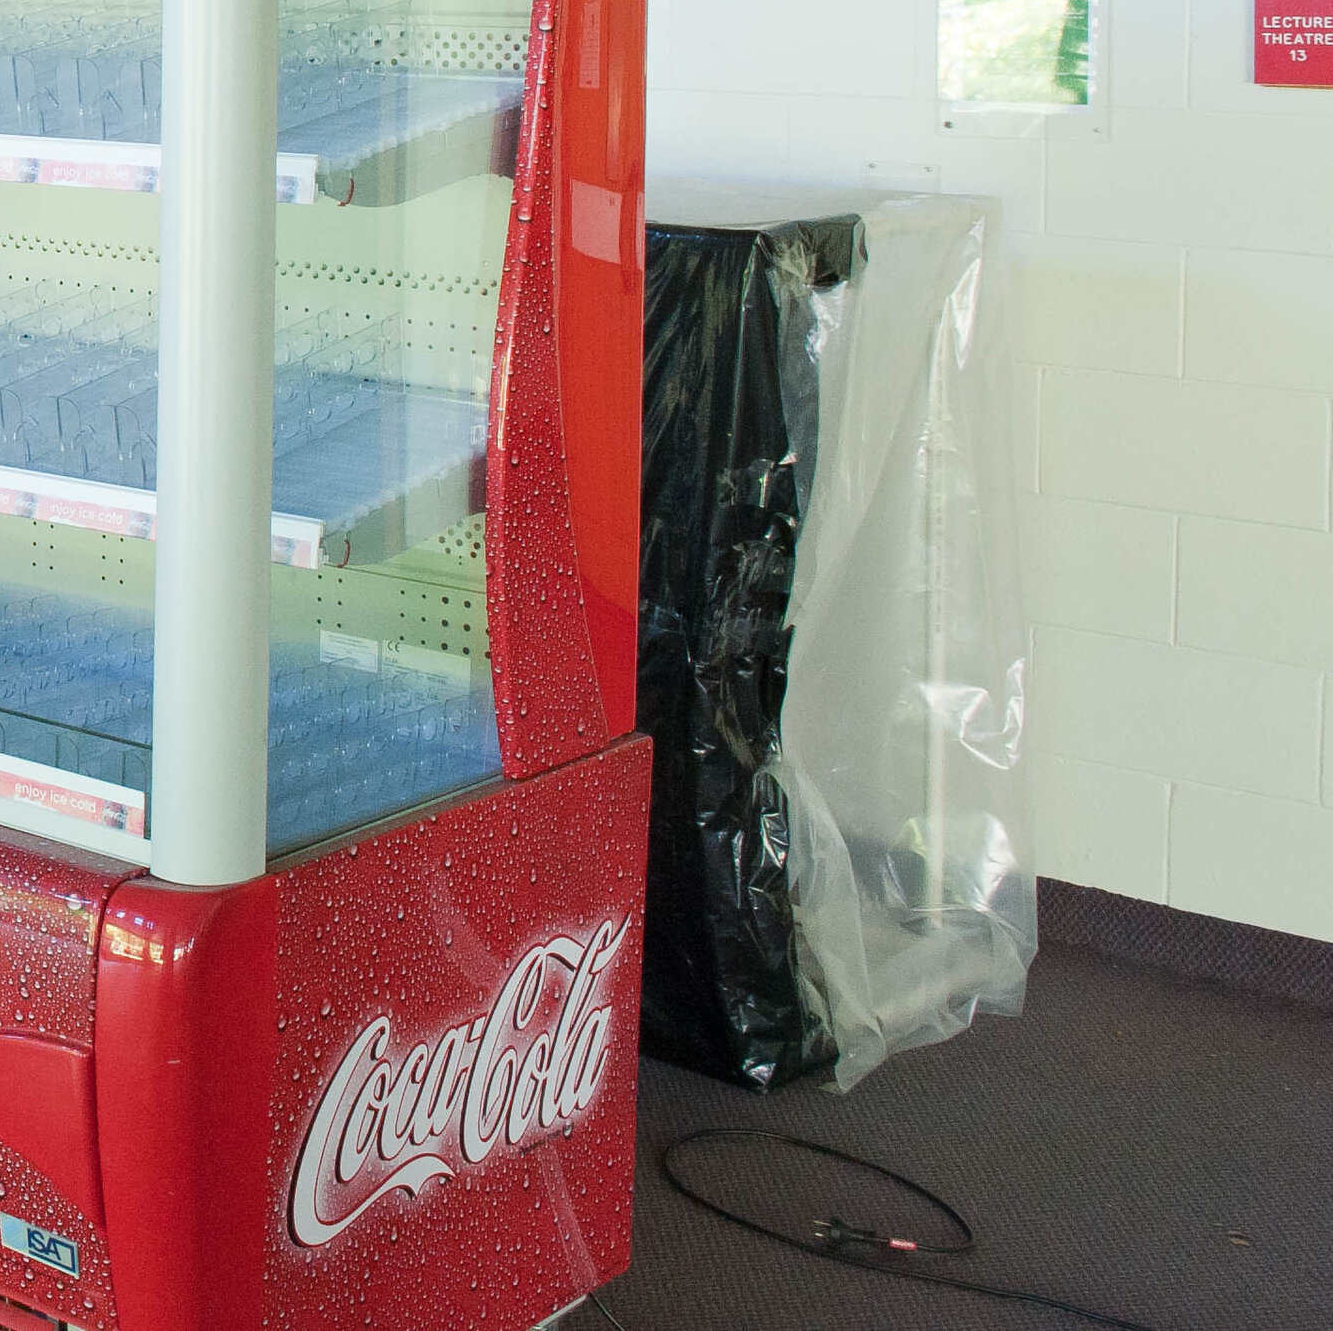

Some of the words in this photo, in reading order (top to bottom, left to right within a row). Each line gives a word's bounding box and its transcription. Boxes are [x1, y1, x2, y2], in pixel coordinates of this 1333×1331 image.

[1262, 16, 1333, 29] LECTURE
[1262, 33, 1333, 45] THEATRE
[1289, 49, 1307, 61] 13
[79, 506, 95, 520] ice
[98, 510, 124, 525] cold
[14, 781, 47, 802] enjoy
[49, 789, 68, 806] ice
[70, 794, 96, 814] cold
[286, 909, 632, 1249] Coca-Cola
